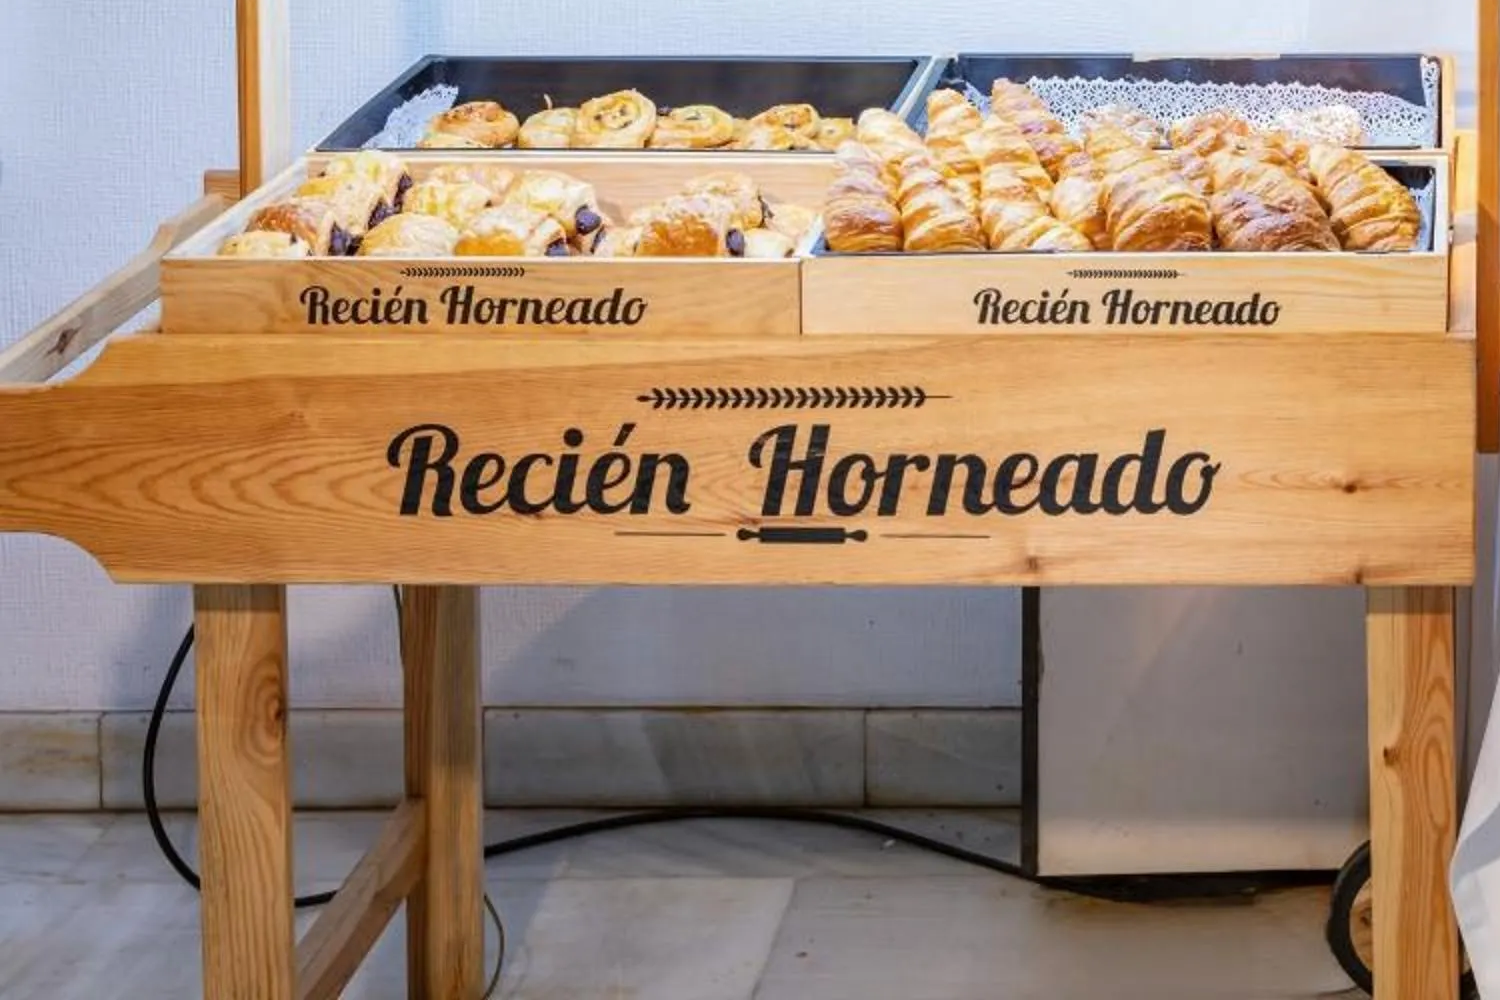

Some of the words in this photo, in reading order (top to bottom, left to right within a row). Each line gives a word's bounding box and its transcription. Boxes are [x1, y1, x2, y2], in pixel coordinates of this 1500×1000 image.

[299, 285, 429, 325] Recién
[440, 285, 648, 326] Horneado
[973, 287, 1091, 325] Recién
[1101, 288, 1282, 326] Horneado
[387, 422, 691, 518] Recién
[748, 423, 1221, 517] Horneado
